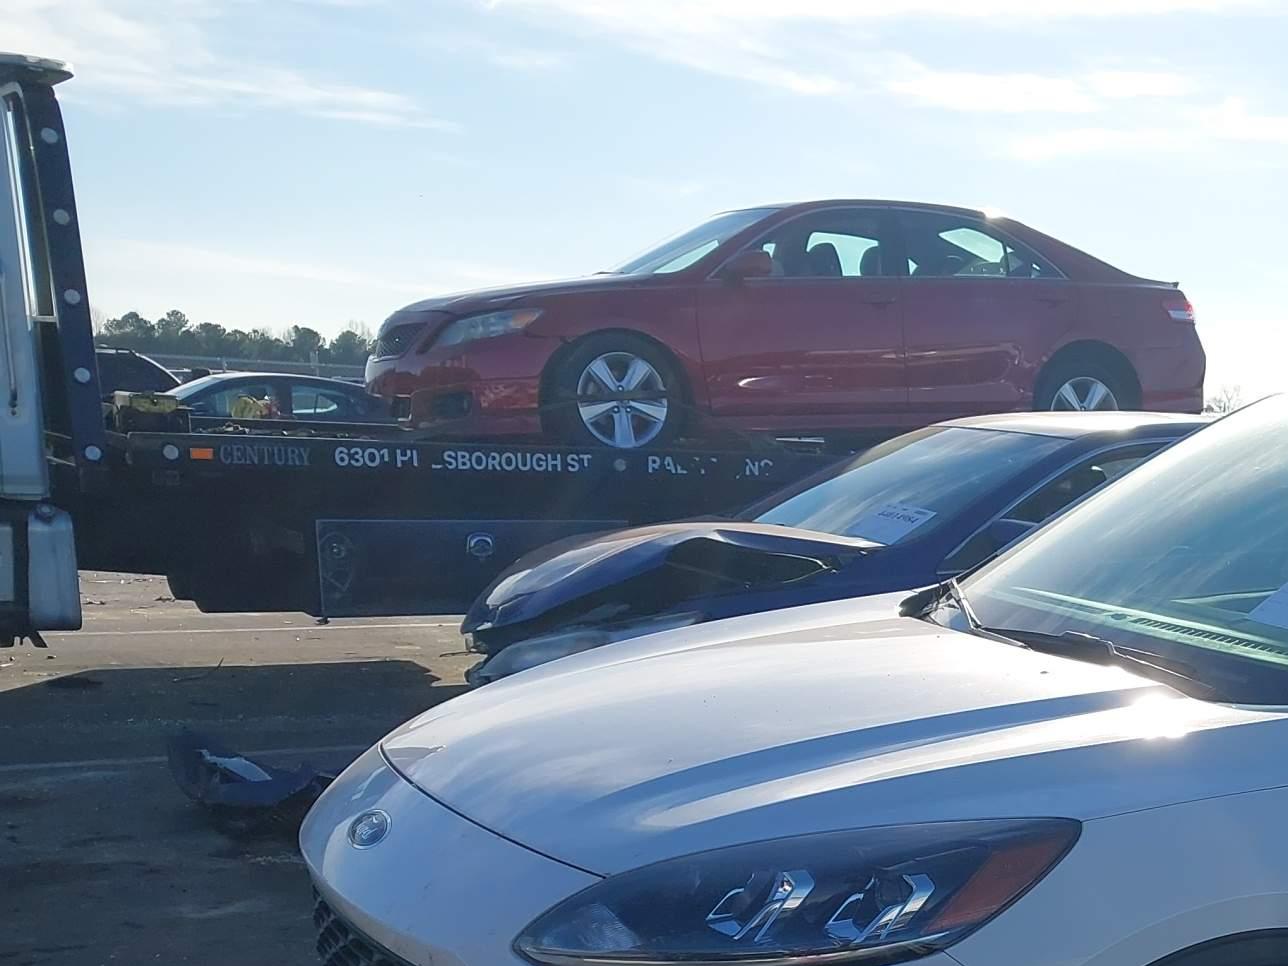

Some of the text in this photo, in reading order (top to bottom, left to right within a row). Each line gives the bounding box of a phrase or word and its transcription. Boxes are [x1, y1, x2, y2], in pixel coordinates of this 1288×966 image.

[219, 443, 312, 466] CENTURY
[334, 446, 389, 467] 6301
[395, 448, 562, 471] HISBOROUGH
[566, 453, 593, 472] ST
